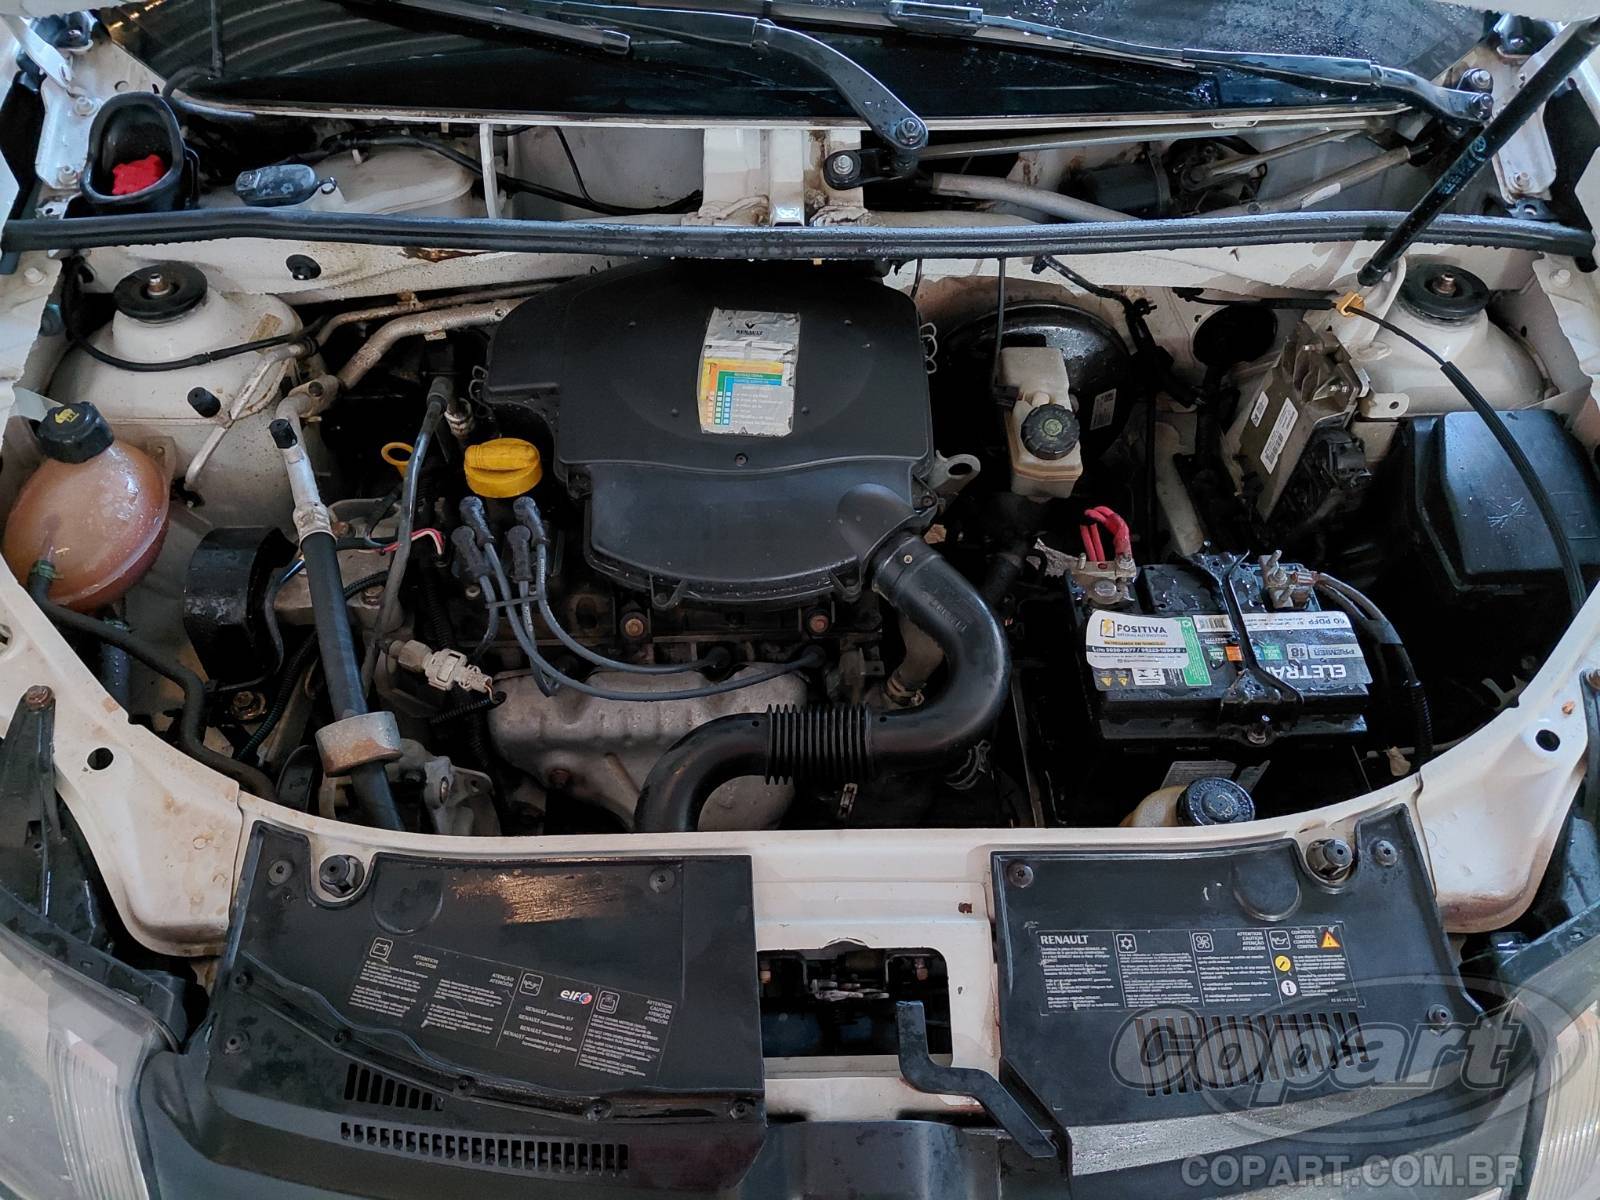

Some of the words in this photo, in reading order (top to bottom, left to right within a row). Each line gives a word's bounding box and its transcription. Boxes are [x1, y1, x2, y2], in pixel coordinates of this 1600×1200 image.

[1116, 624, 1167, 634] POSITIVA
[1290, 648, 1306, 658] 18
[1314, 648, 1356, 656] PREMIER
[1040, 935, 1088, 944] RENAULT
[492, 973, 514, 982] ATENÇÃO
[560, 990, 581, 1000] elf
[646, 1000, 672, 1009] ATTENTION
[649, 1006, 671, 1014] CAUTION
[648, 1011, 670, 1019] ATENÇÃO
